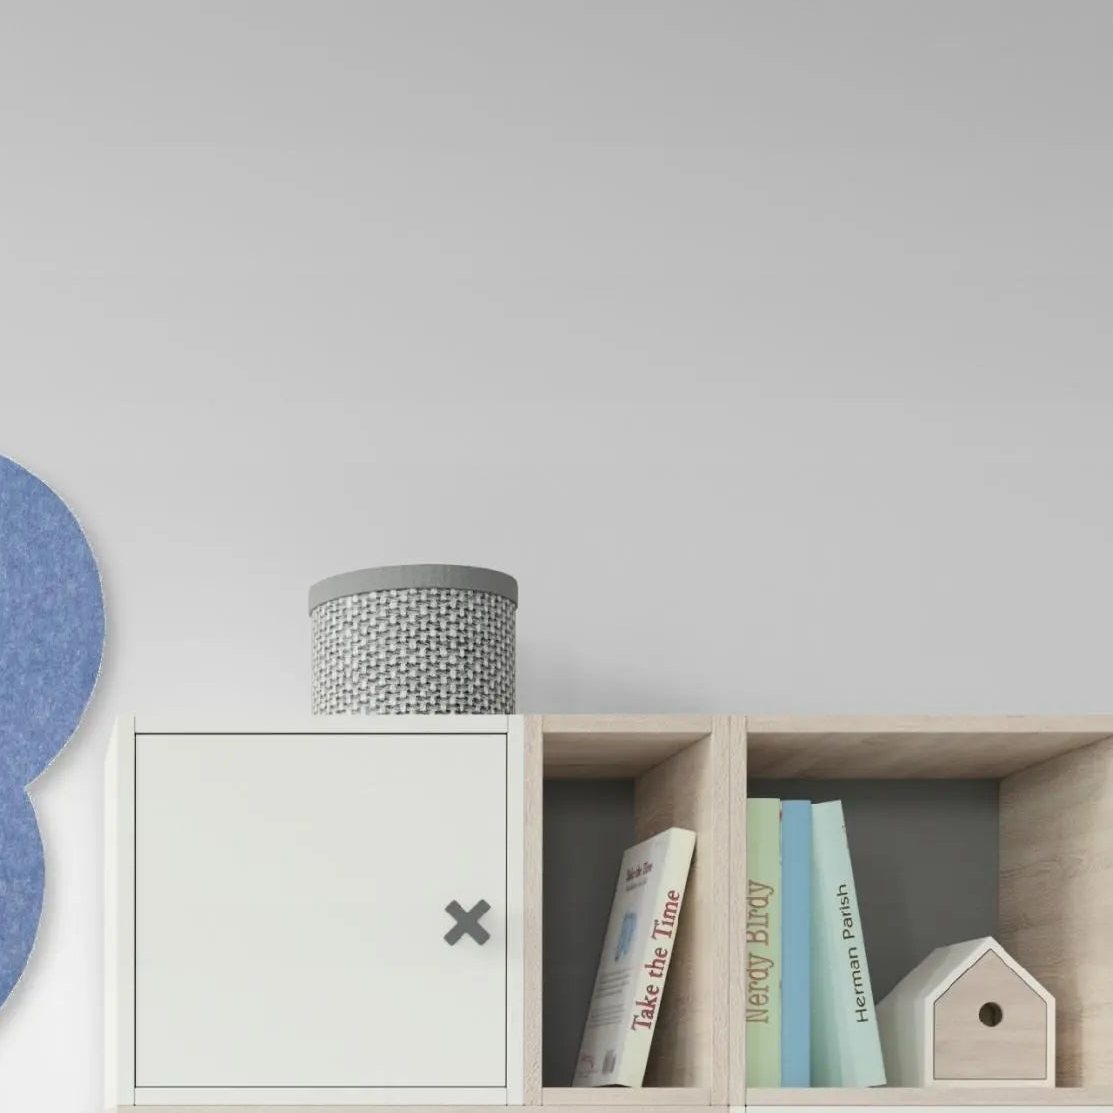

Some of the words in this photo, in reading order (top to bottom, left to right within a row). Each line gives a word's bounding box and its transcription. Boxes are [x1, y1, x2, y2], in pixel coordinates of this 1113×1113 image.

[652, 890, 680, 939] Time
[837, 884, 855, 940] Parish
[645, 947, 668, 978] the
[746, 953, 774, 1023] Nerdy
[848, 947, 869, 1023] Herman
[631, 985, 660, 1031] Take
